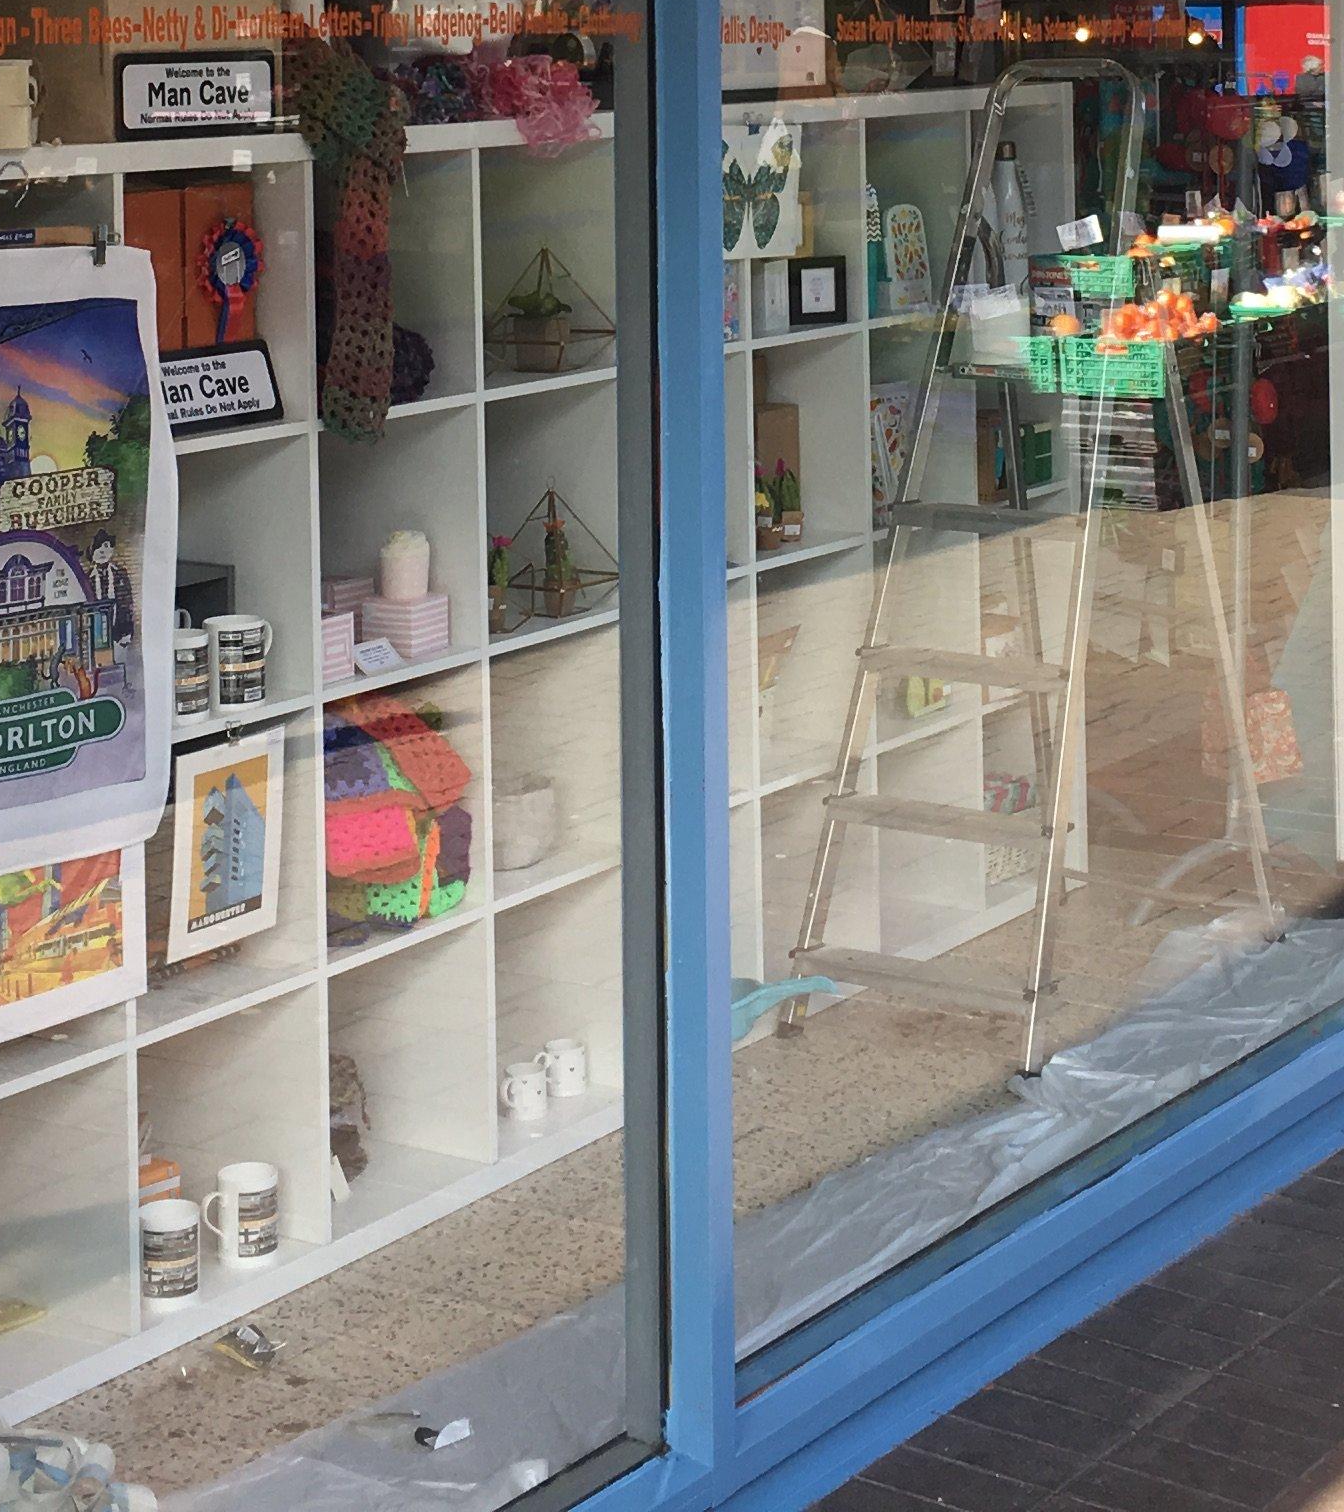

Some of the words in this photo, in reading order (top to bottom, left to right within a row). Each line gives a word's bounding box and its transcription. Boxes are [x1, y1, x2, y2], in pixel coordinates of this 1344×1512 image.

[194, 5, 207, 41] &
[165, 67, 203, 78] Welcome
[205, 67, 215, 77] to
[217, 66, 231, 77] the
[147, 82, 191, 107] Man
[199, 80, 249, 105] Cave
[161, 362, 200, 377] Welcome
[201, 362, 211, 372] to
[212, 360, 226, 371] the
[198, 374, 249, 399] Cave
[181, 406, 203, 419] Rules
[206, 403, 217, 414] Do
[220, 401, 235, 412] Not
[237, 397, 260, 411] Apply
[38, 491, 76, 509] FAMILY
